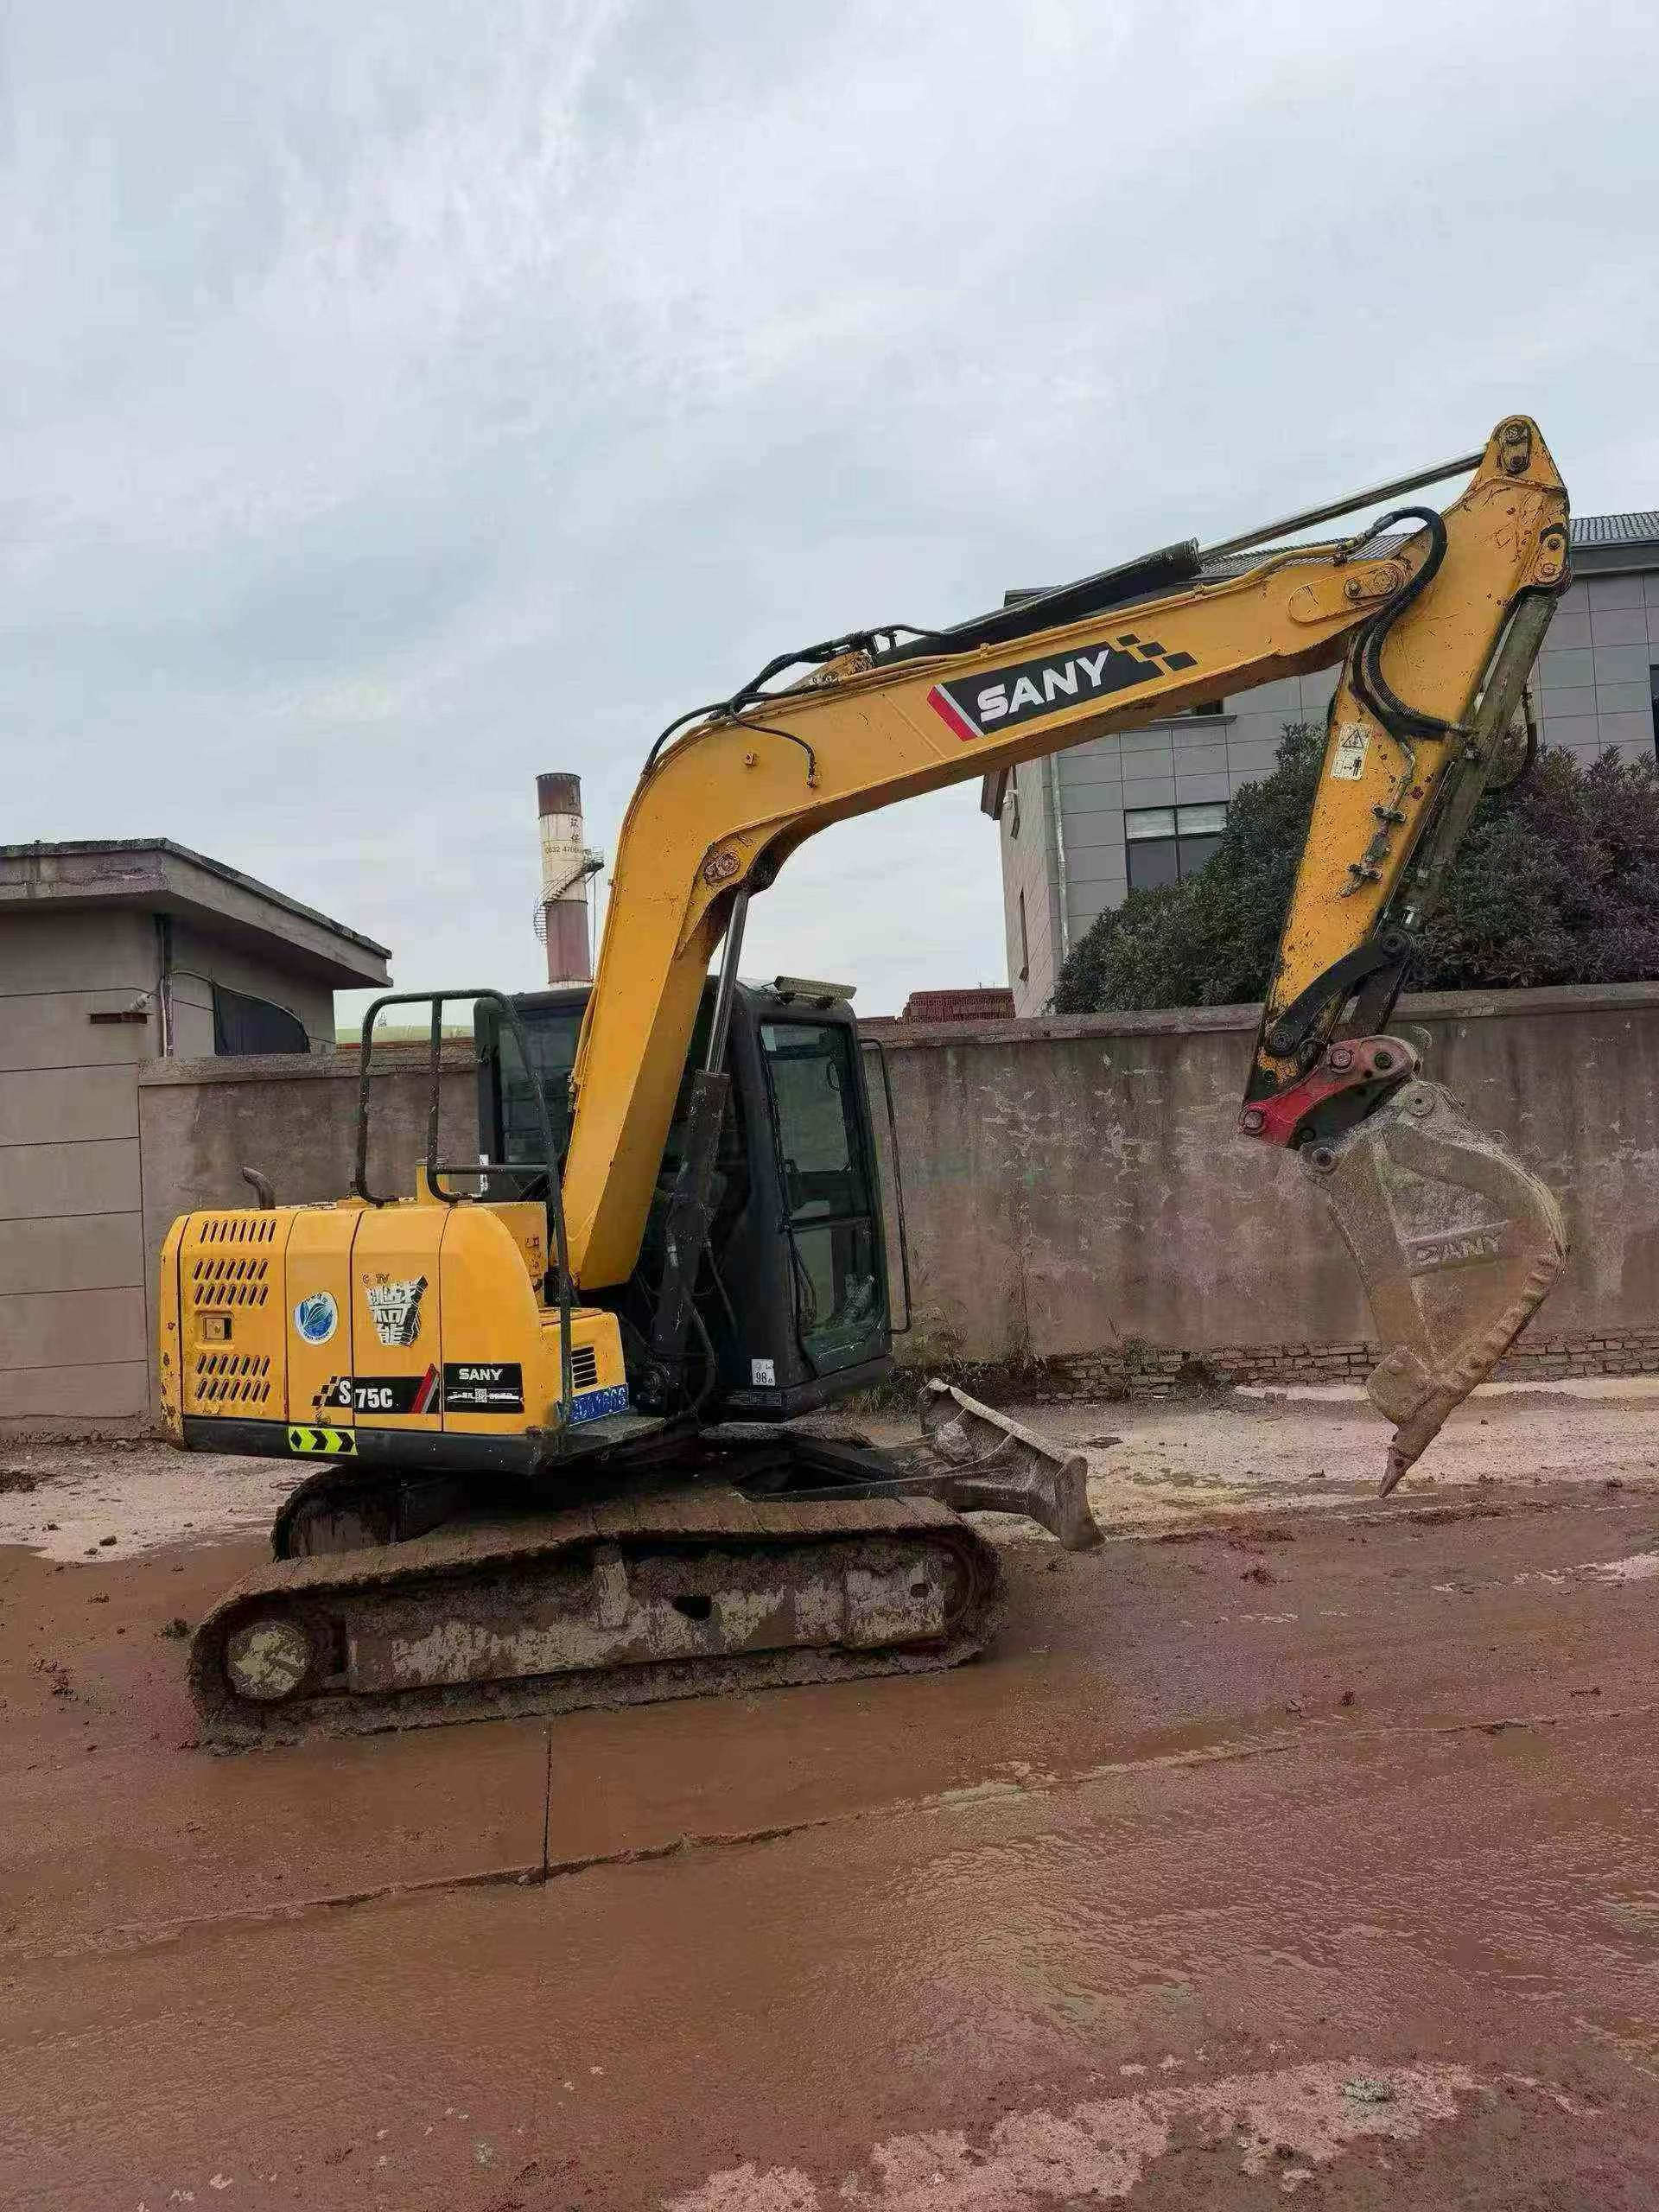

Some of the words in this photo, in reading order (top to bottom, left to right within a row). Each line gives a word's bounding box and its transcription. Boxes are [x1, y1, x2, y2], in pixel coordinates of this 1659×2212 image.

[977, 649, 1109, 722] SANY
[459, 1368, 504, 1381] SANY
[354, 1388, 393, 1408] 75C
